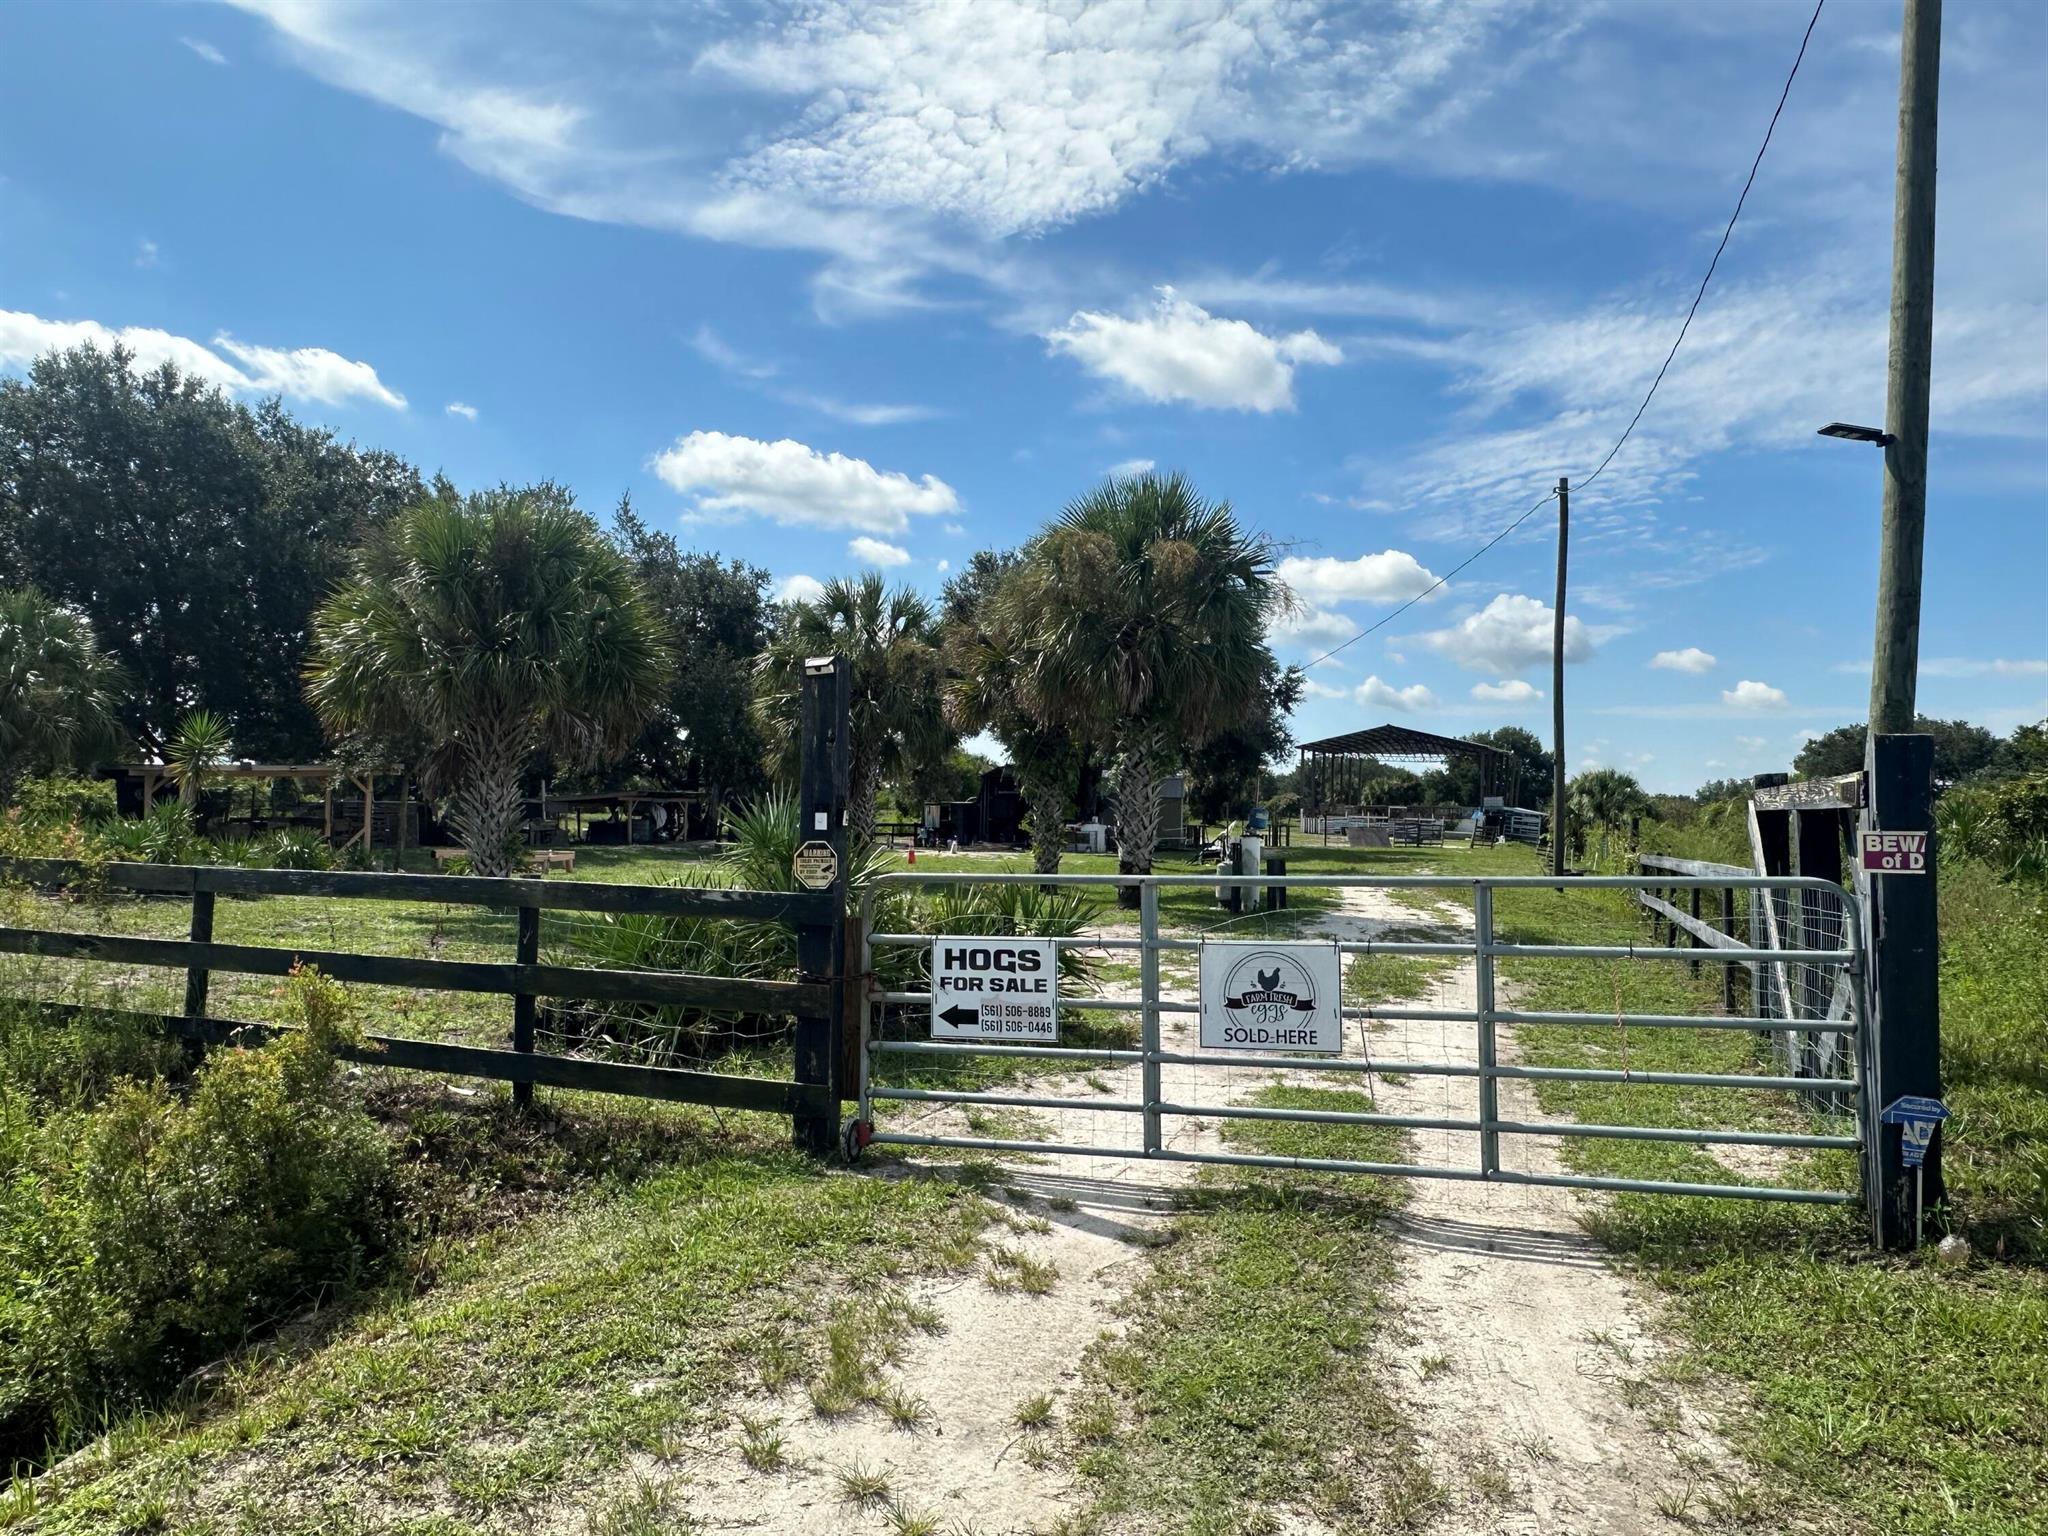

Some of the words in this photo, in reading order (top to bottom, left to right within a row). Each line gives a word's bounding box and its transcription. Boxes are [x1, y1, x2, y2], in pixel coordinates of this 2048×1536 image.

[1881, 853, 1902, 868] of
[945, 948, 1041, 974] HOGS
[940, 977, 983, 991] FOR
[989, 978, 1047, 993] SALE
[1245, 992, 1268, 1004] FARM
[1269, 992, 1293, 1004] FRESH
[981, 1004, 1002, 1017] (561)
[1005, 1005, 1051, 1018] 506-8889
[1251, 1004, 1288, 1024] eggs
[981, 1019, 1002, 1032] (561)
[1005, 1021, 1053, 1033] 506-0446
[1224, 1028, 1269, 1043] SOLD
[1276, 1029, 1318, 1045] HERE
